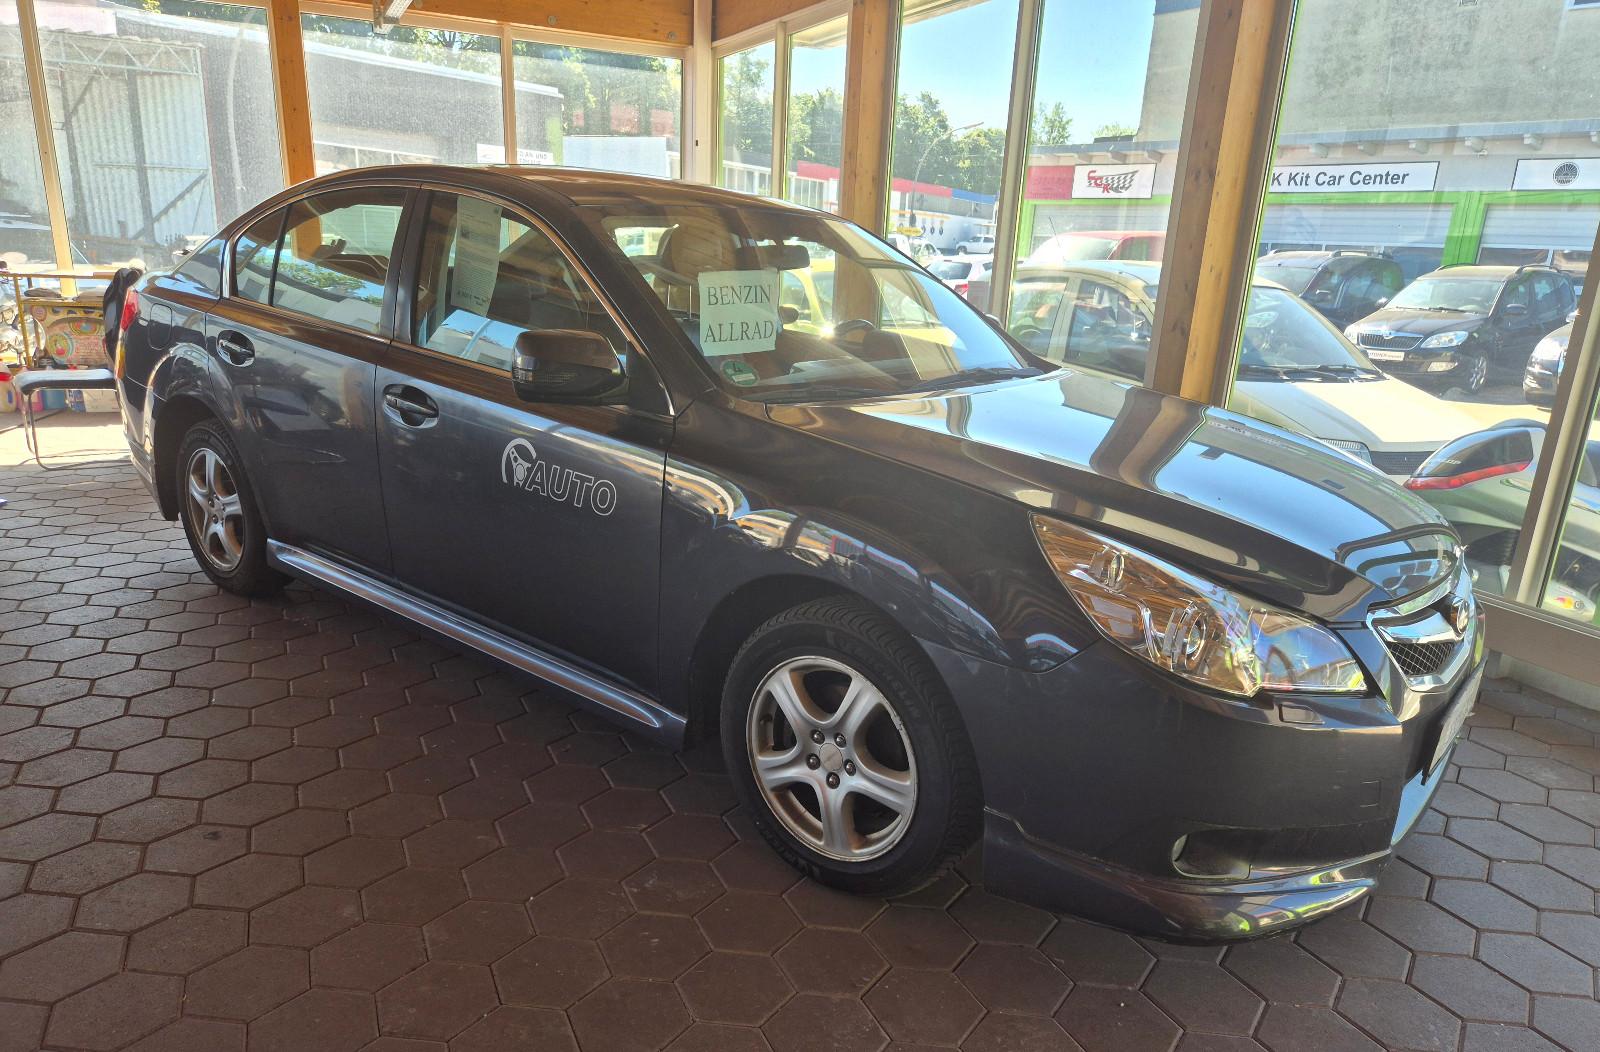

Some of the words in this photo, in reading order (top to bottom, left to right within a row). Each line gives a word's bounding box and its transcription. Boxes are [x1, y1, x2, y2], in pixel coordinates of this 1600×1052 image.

[1287, 171, 1311, 186] Kit
[1314, 171, 1345, 186] Car
[1349, 170, 1410, 185] Center
[706, 284, 771, 306] BENZIN
[704, 320, 775, 343] ALLRAD
[525, 460, 617, 516] AUTO
